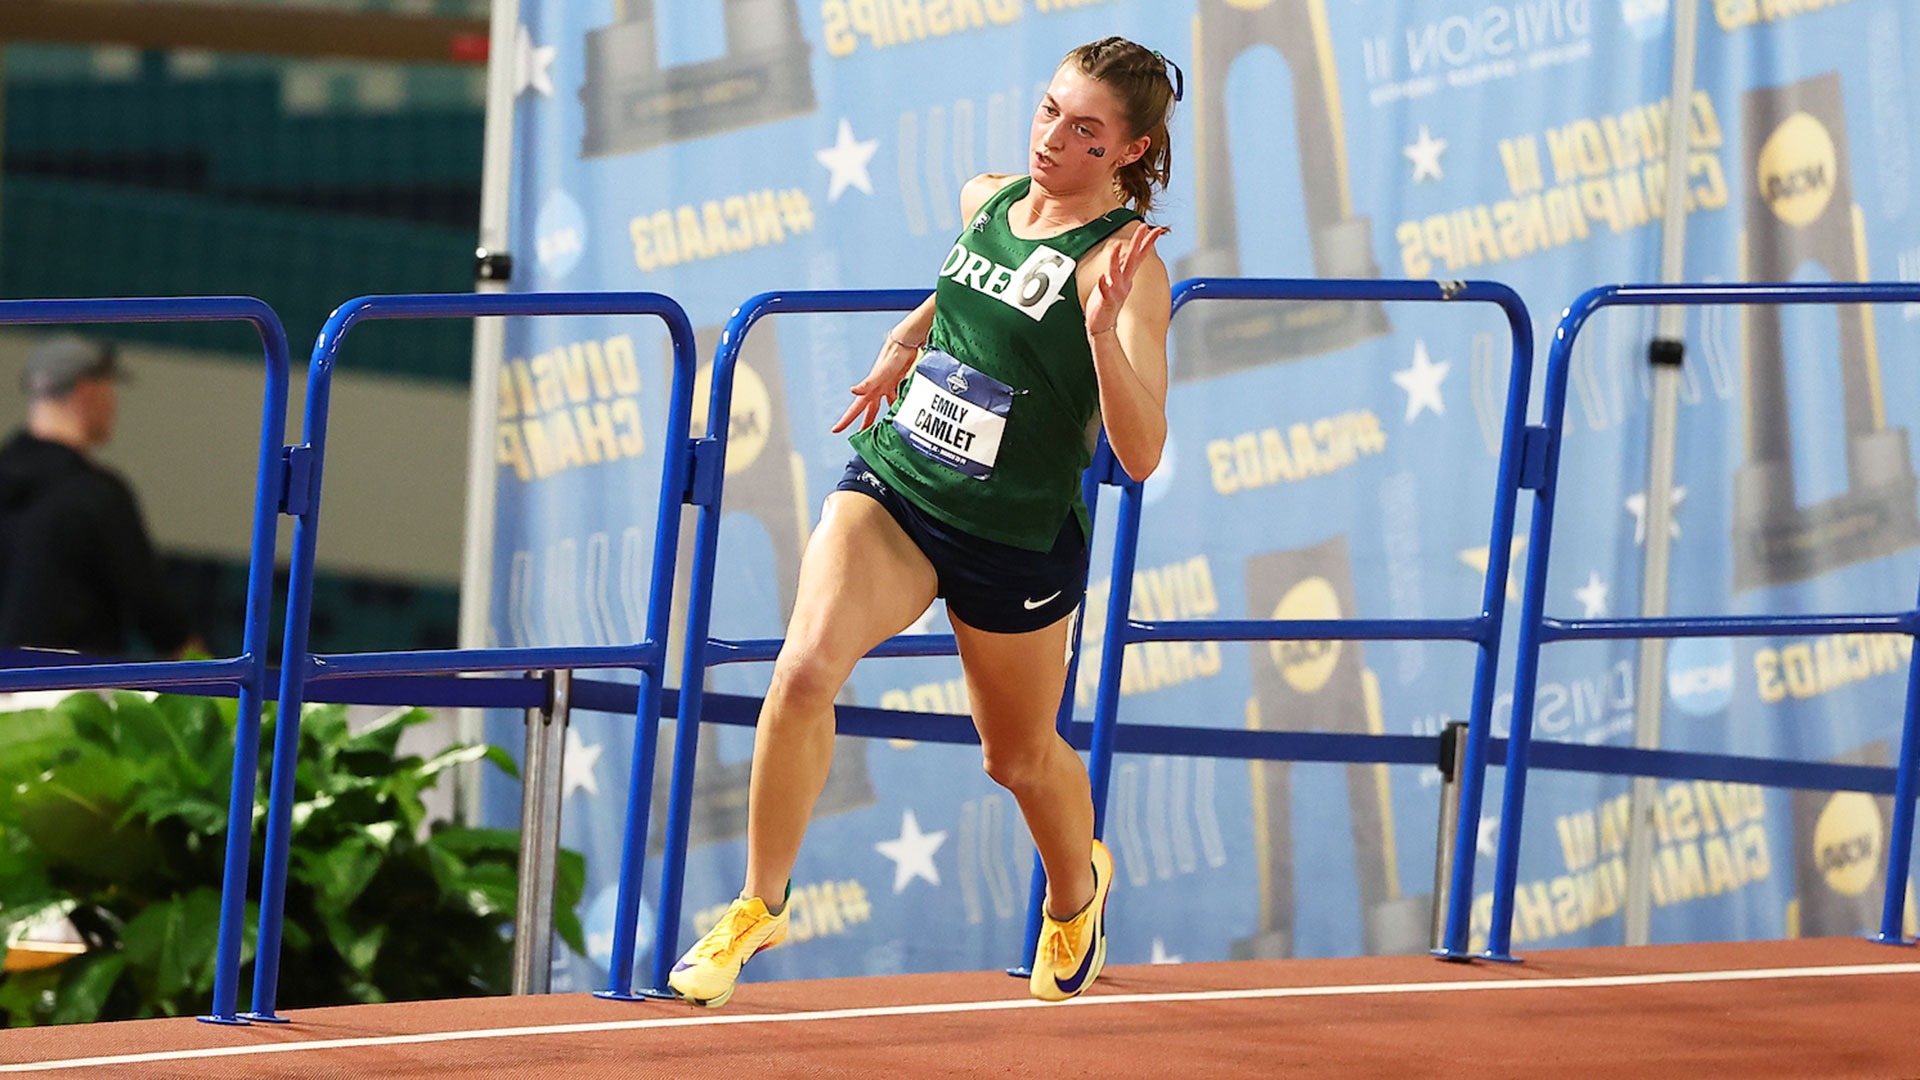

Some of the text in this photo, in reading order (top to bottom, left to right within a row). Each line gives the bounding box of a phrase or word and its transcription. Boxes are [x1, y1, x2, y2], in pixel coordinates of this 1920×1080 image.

[1017, 255, 1065, 307] 6
[914, 408, 976, 453] CAMLET
[931, 394, 969, 424] EMILY
